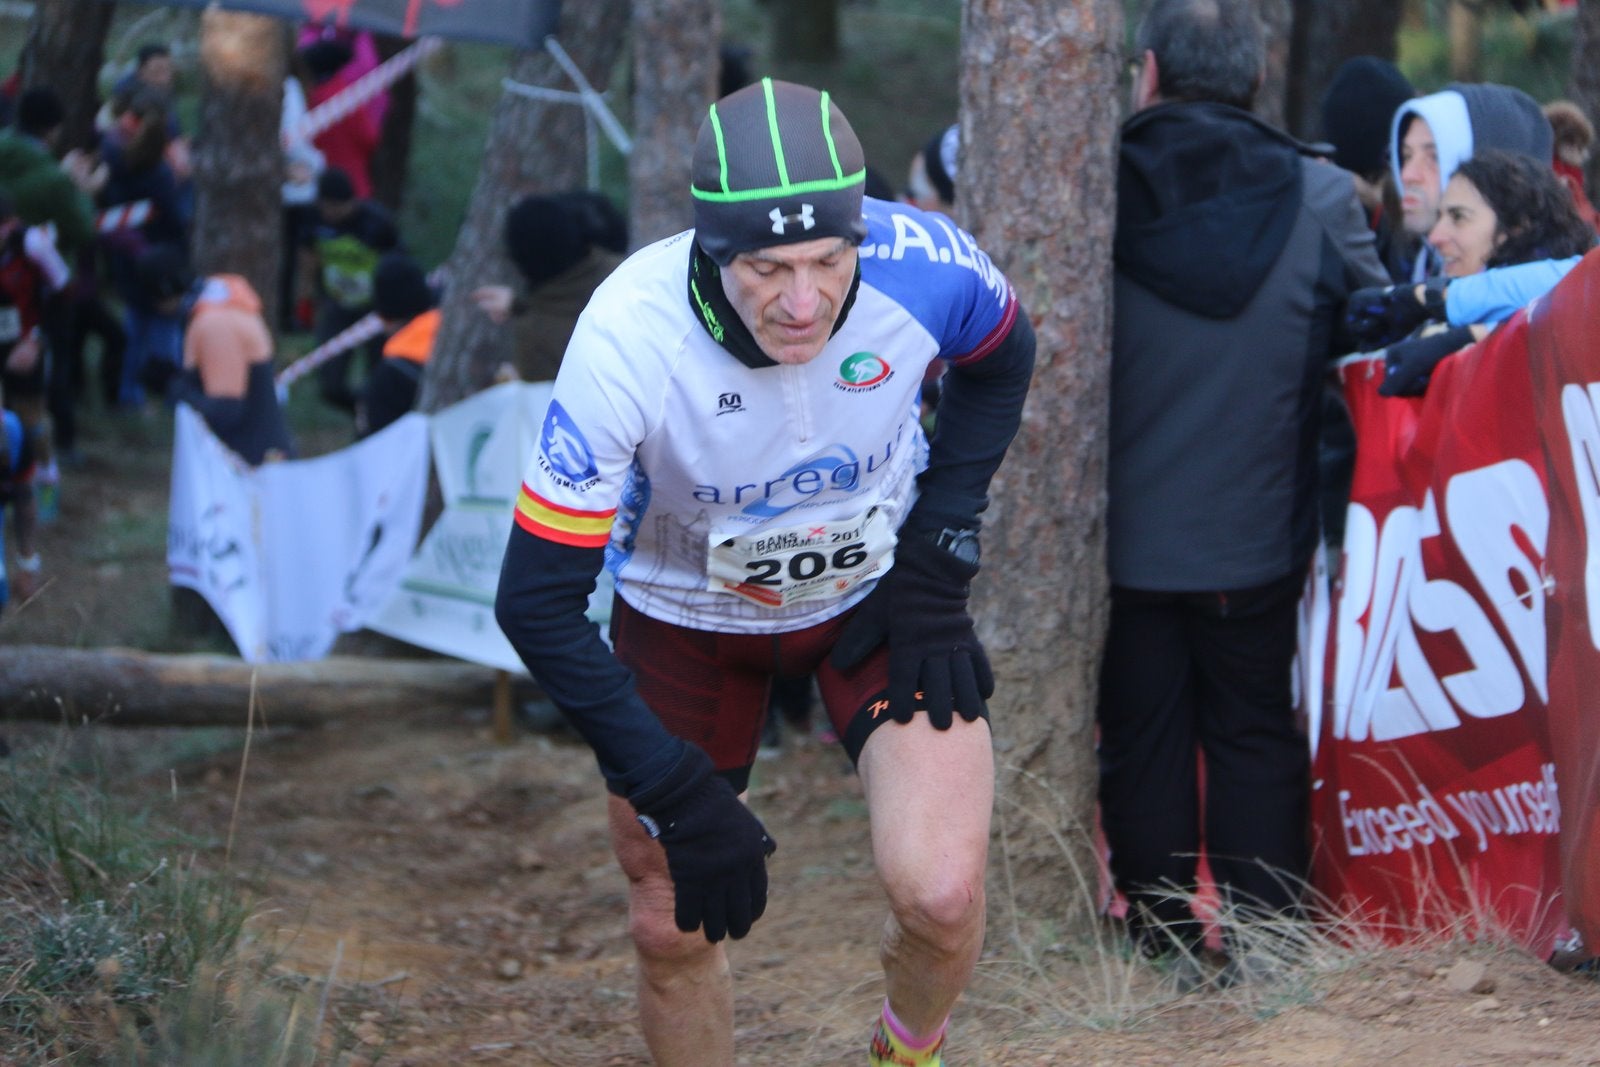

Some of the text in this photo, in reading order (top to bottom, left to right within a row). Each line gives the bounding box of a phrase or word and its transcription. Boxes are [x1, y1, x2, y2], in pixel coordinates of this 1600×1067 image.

[692, 424, 903, 505] arregui
[745, 542, 869, 586] 206
[831, 528, 860, 543] 201
[1338, 784, 1460, 856] Exceed
